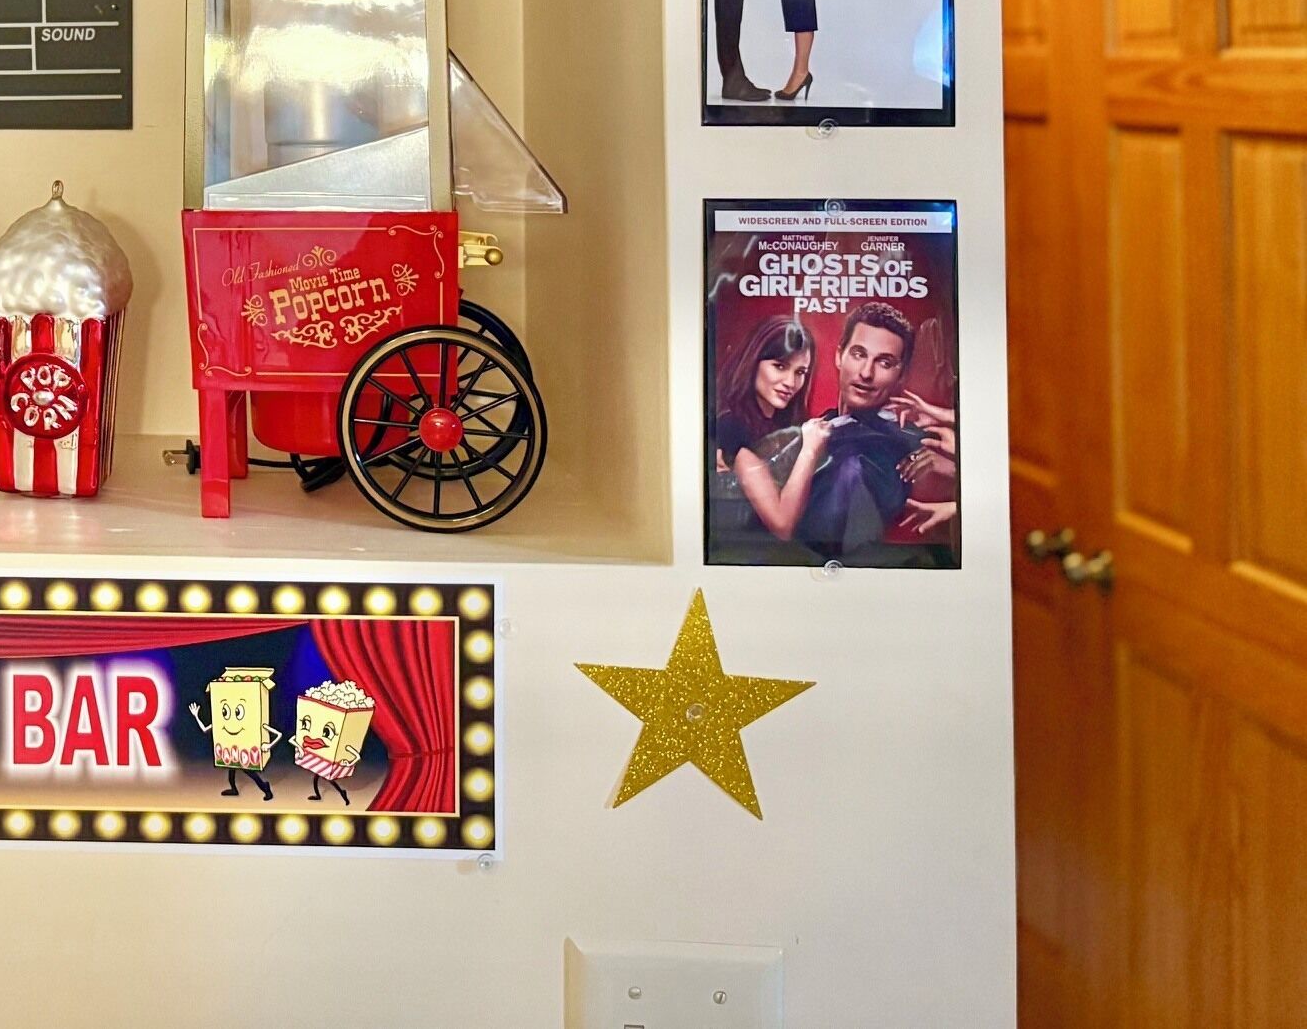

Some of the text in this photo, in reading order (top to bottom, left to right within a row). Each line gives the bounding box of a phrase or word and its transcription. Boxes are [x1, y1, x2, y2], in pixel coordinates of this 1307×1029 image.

[41, 28, 96, 42] SOUND
[738, 217, 928, 227] WIDESCREEN AND FULL-SCREEN EDITION
[861, 241, 905, 251] GARNER
[759, 253, 913, 276] GHOSTS OF
[288, 266, 361, 293] Movie Time
[739, 275, 928, 299] GIRLFRIENDS
[794, 297, 850, 313] PAST
[20, 362, 72, 391] POP
[10, 392, 78, 431] CORN
[15, 670, 165, 768] BAR
[215, 744, 261, 767] CANDY
